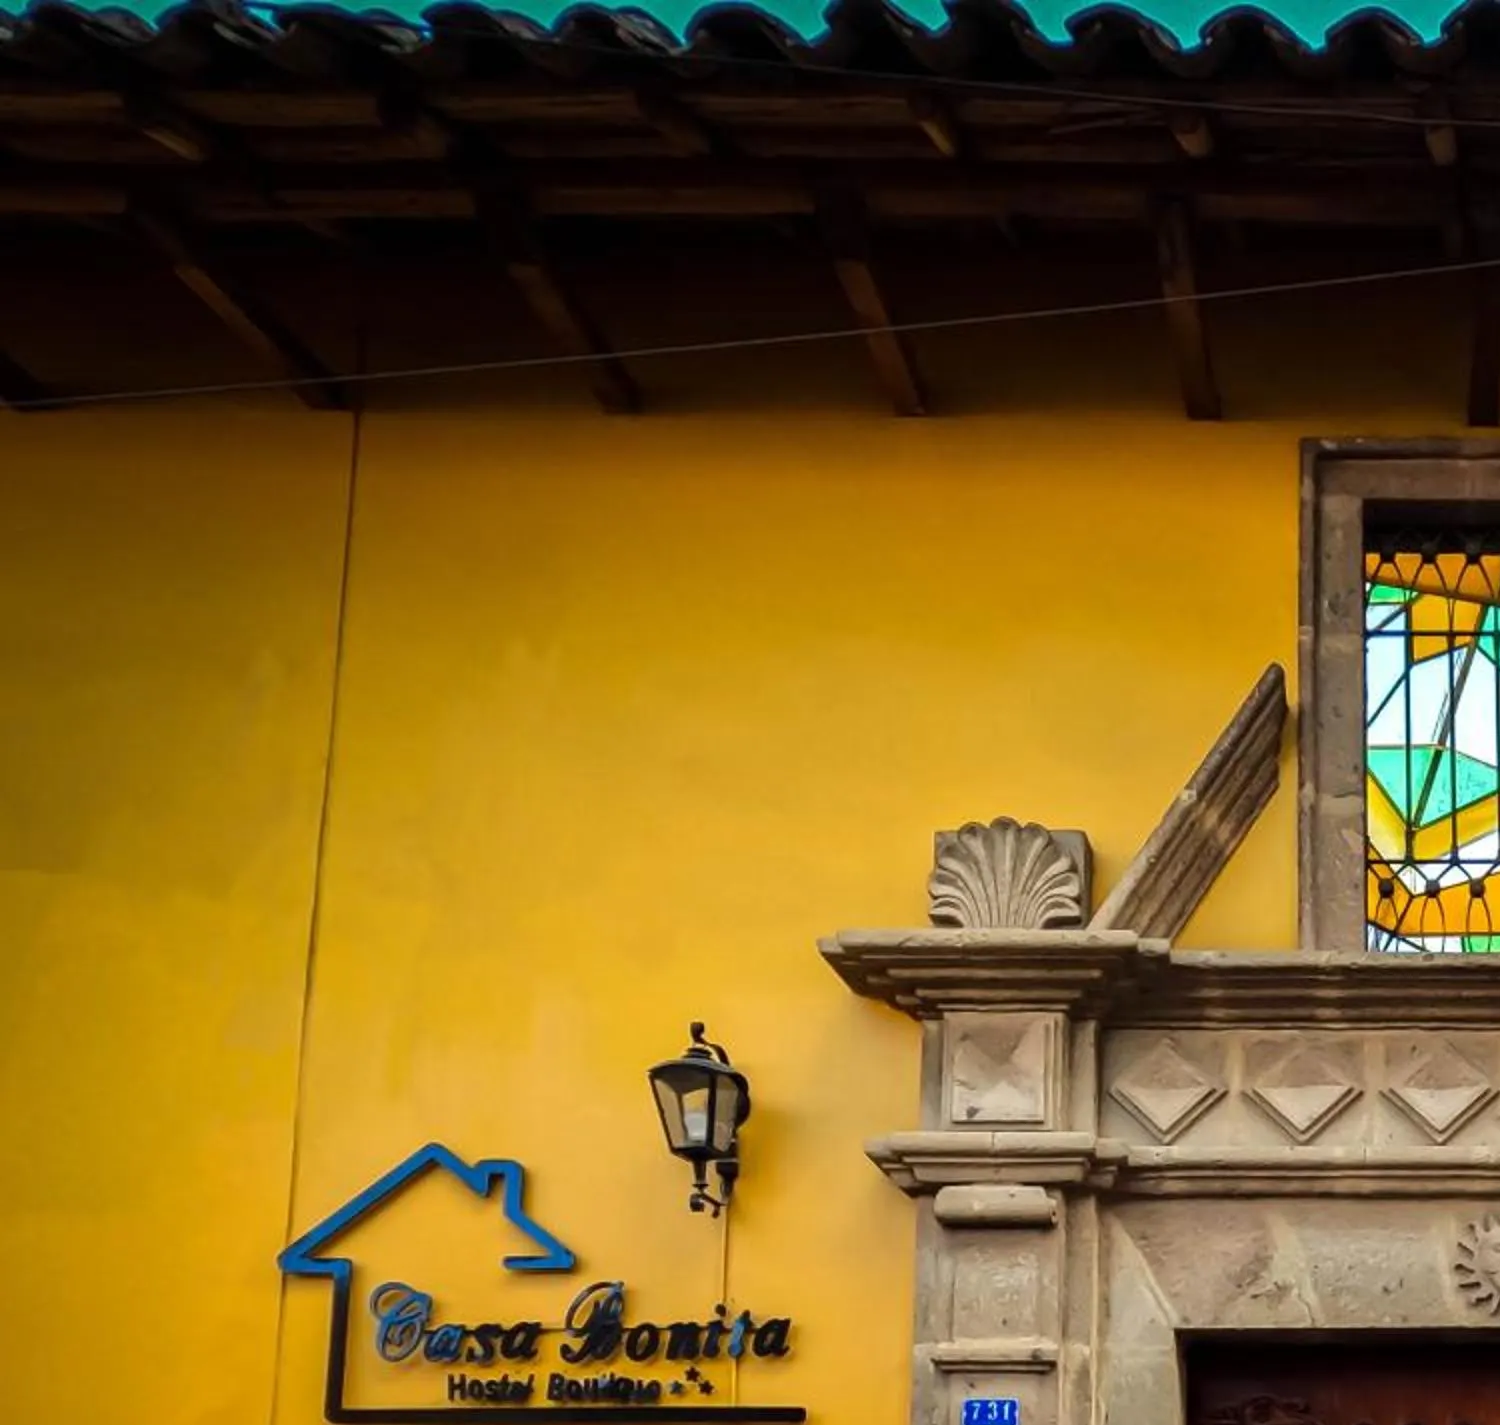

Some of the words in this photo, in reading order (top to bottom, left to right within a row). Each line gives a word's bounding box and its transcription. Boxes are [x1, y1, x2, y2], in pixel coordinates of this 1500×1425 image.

[369, 1281, 541, 1364] Casa
[560, 1281, 792, 1364] Bonita
[972, 1401, 1011, 1420] 731
